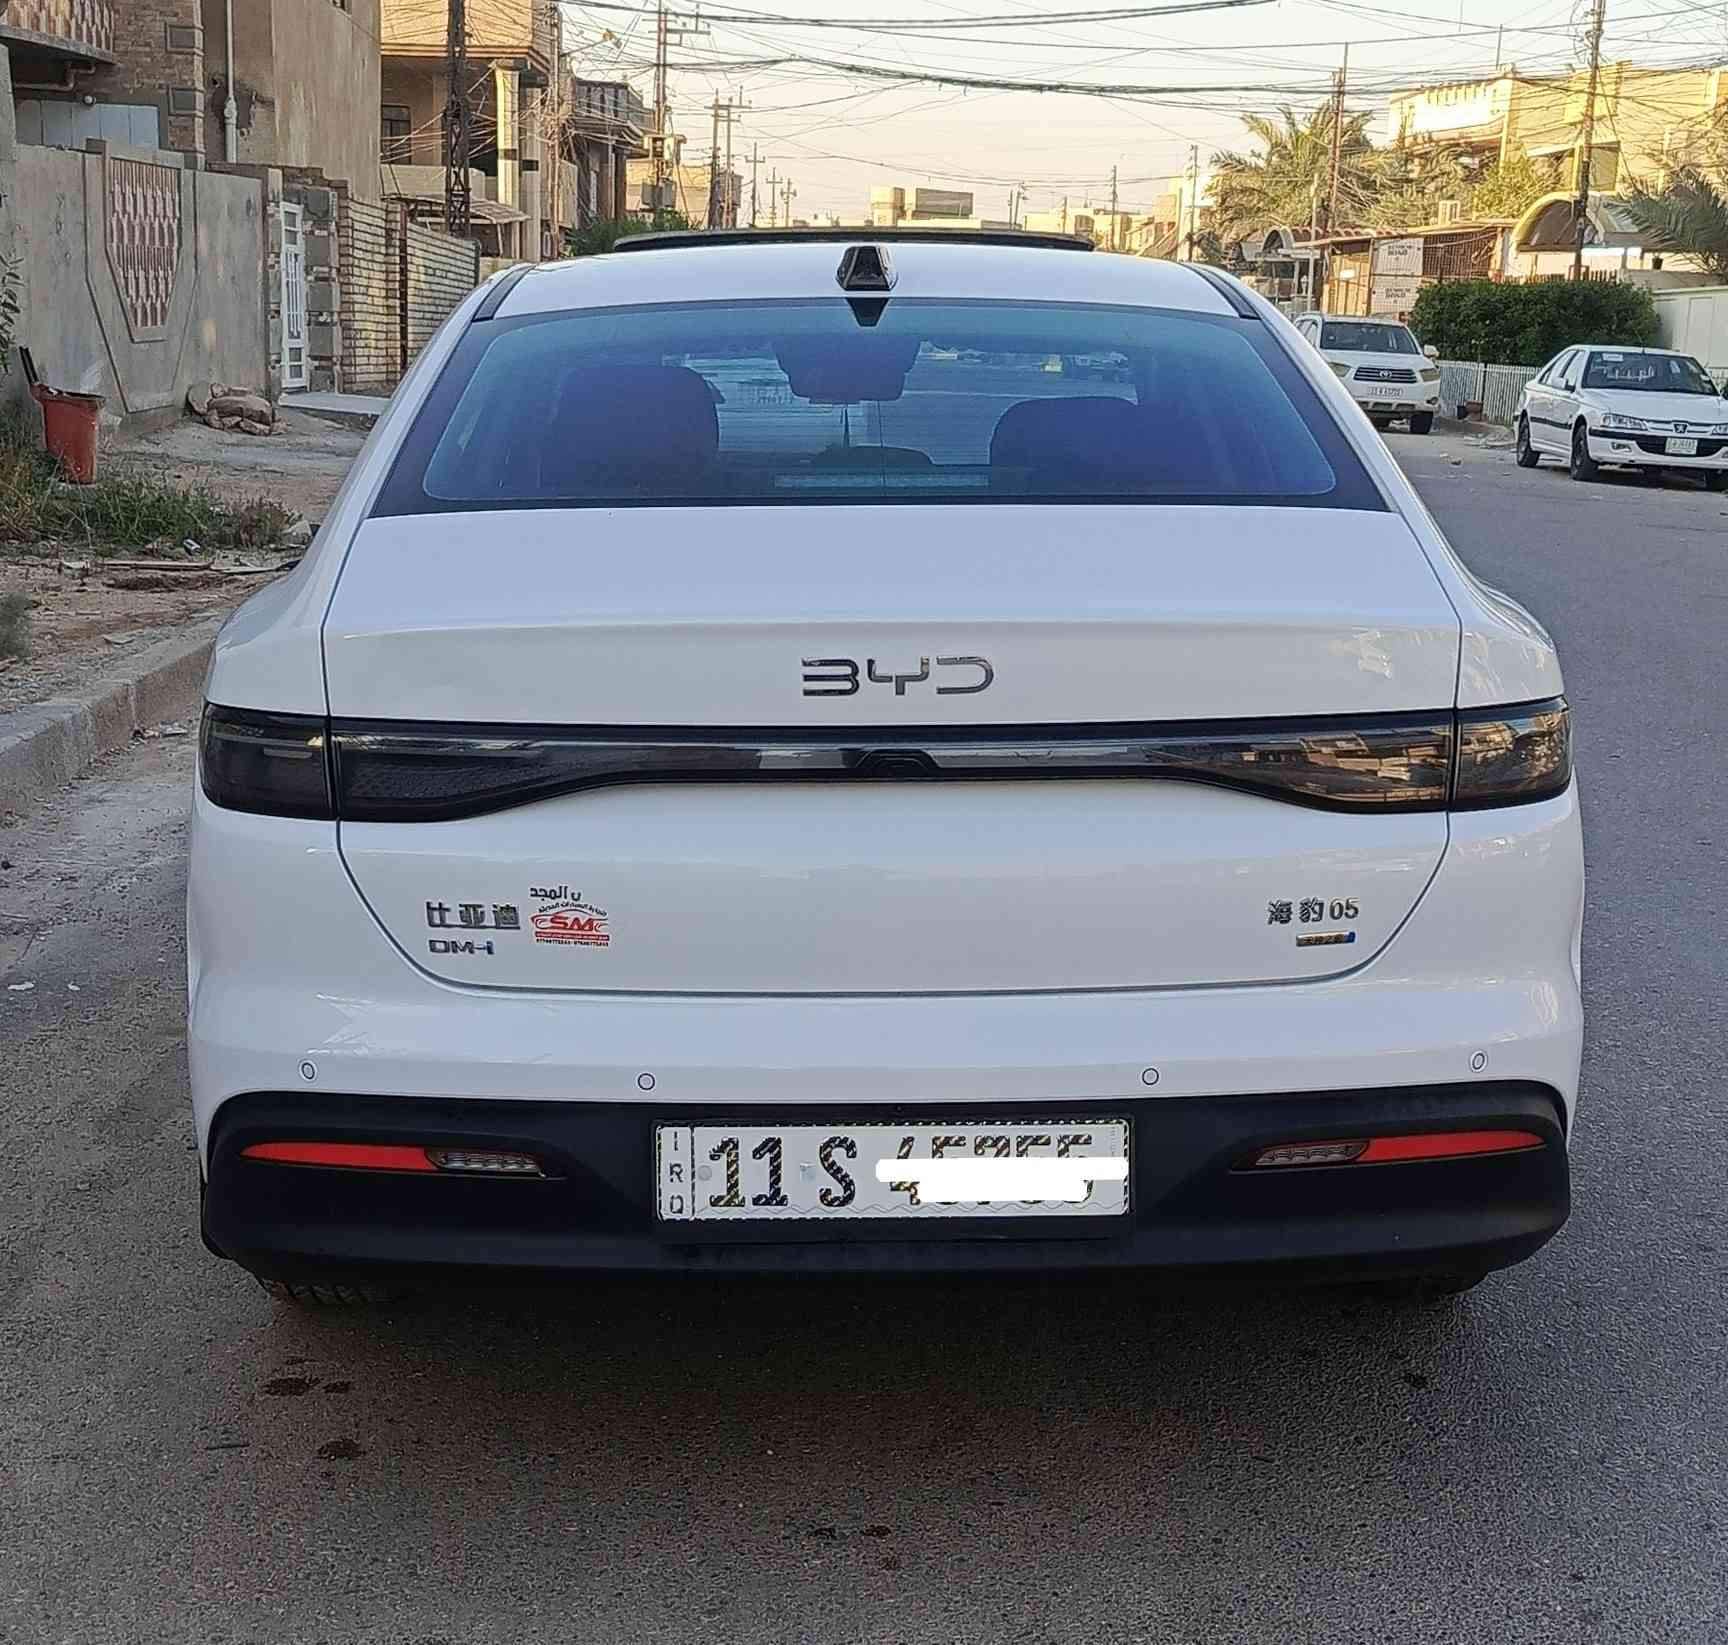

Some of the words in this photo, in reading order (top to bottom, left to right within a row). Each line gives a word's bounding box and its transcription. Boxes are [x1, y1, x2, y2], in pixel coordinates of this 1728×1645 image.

[802, 656, 994, 696] BYD
[426, 901, 521, 930] 比亚迪
[709, 1137, 788, 1207] 11
[819, 1136, 857, 1207] S
